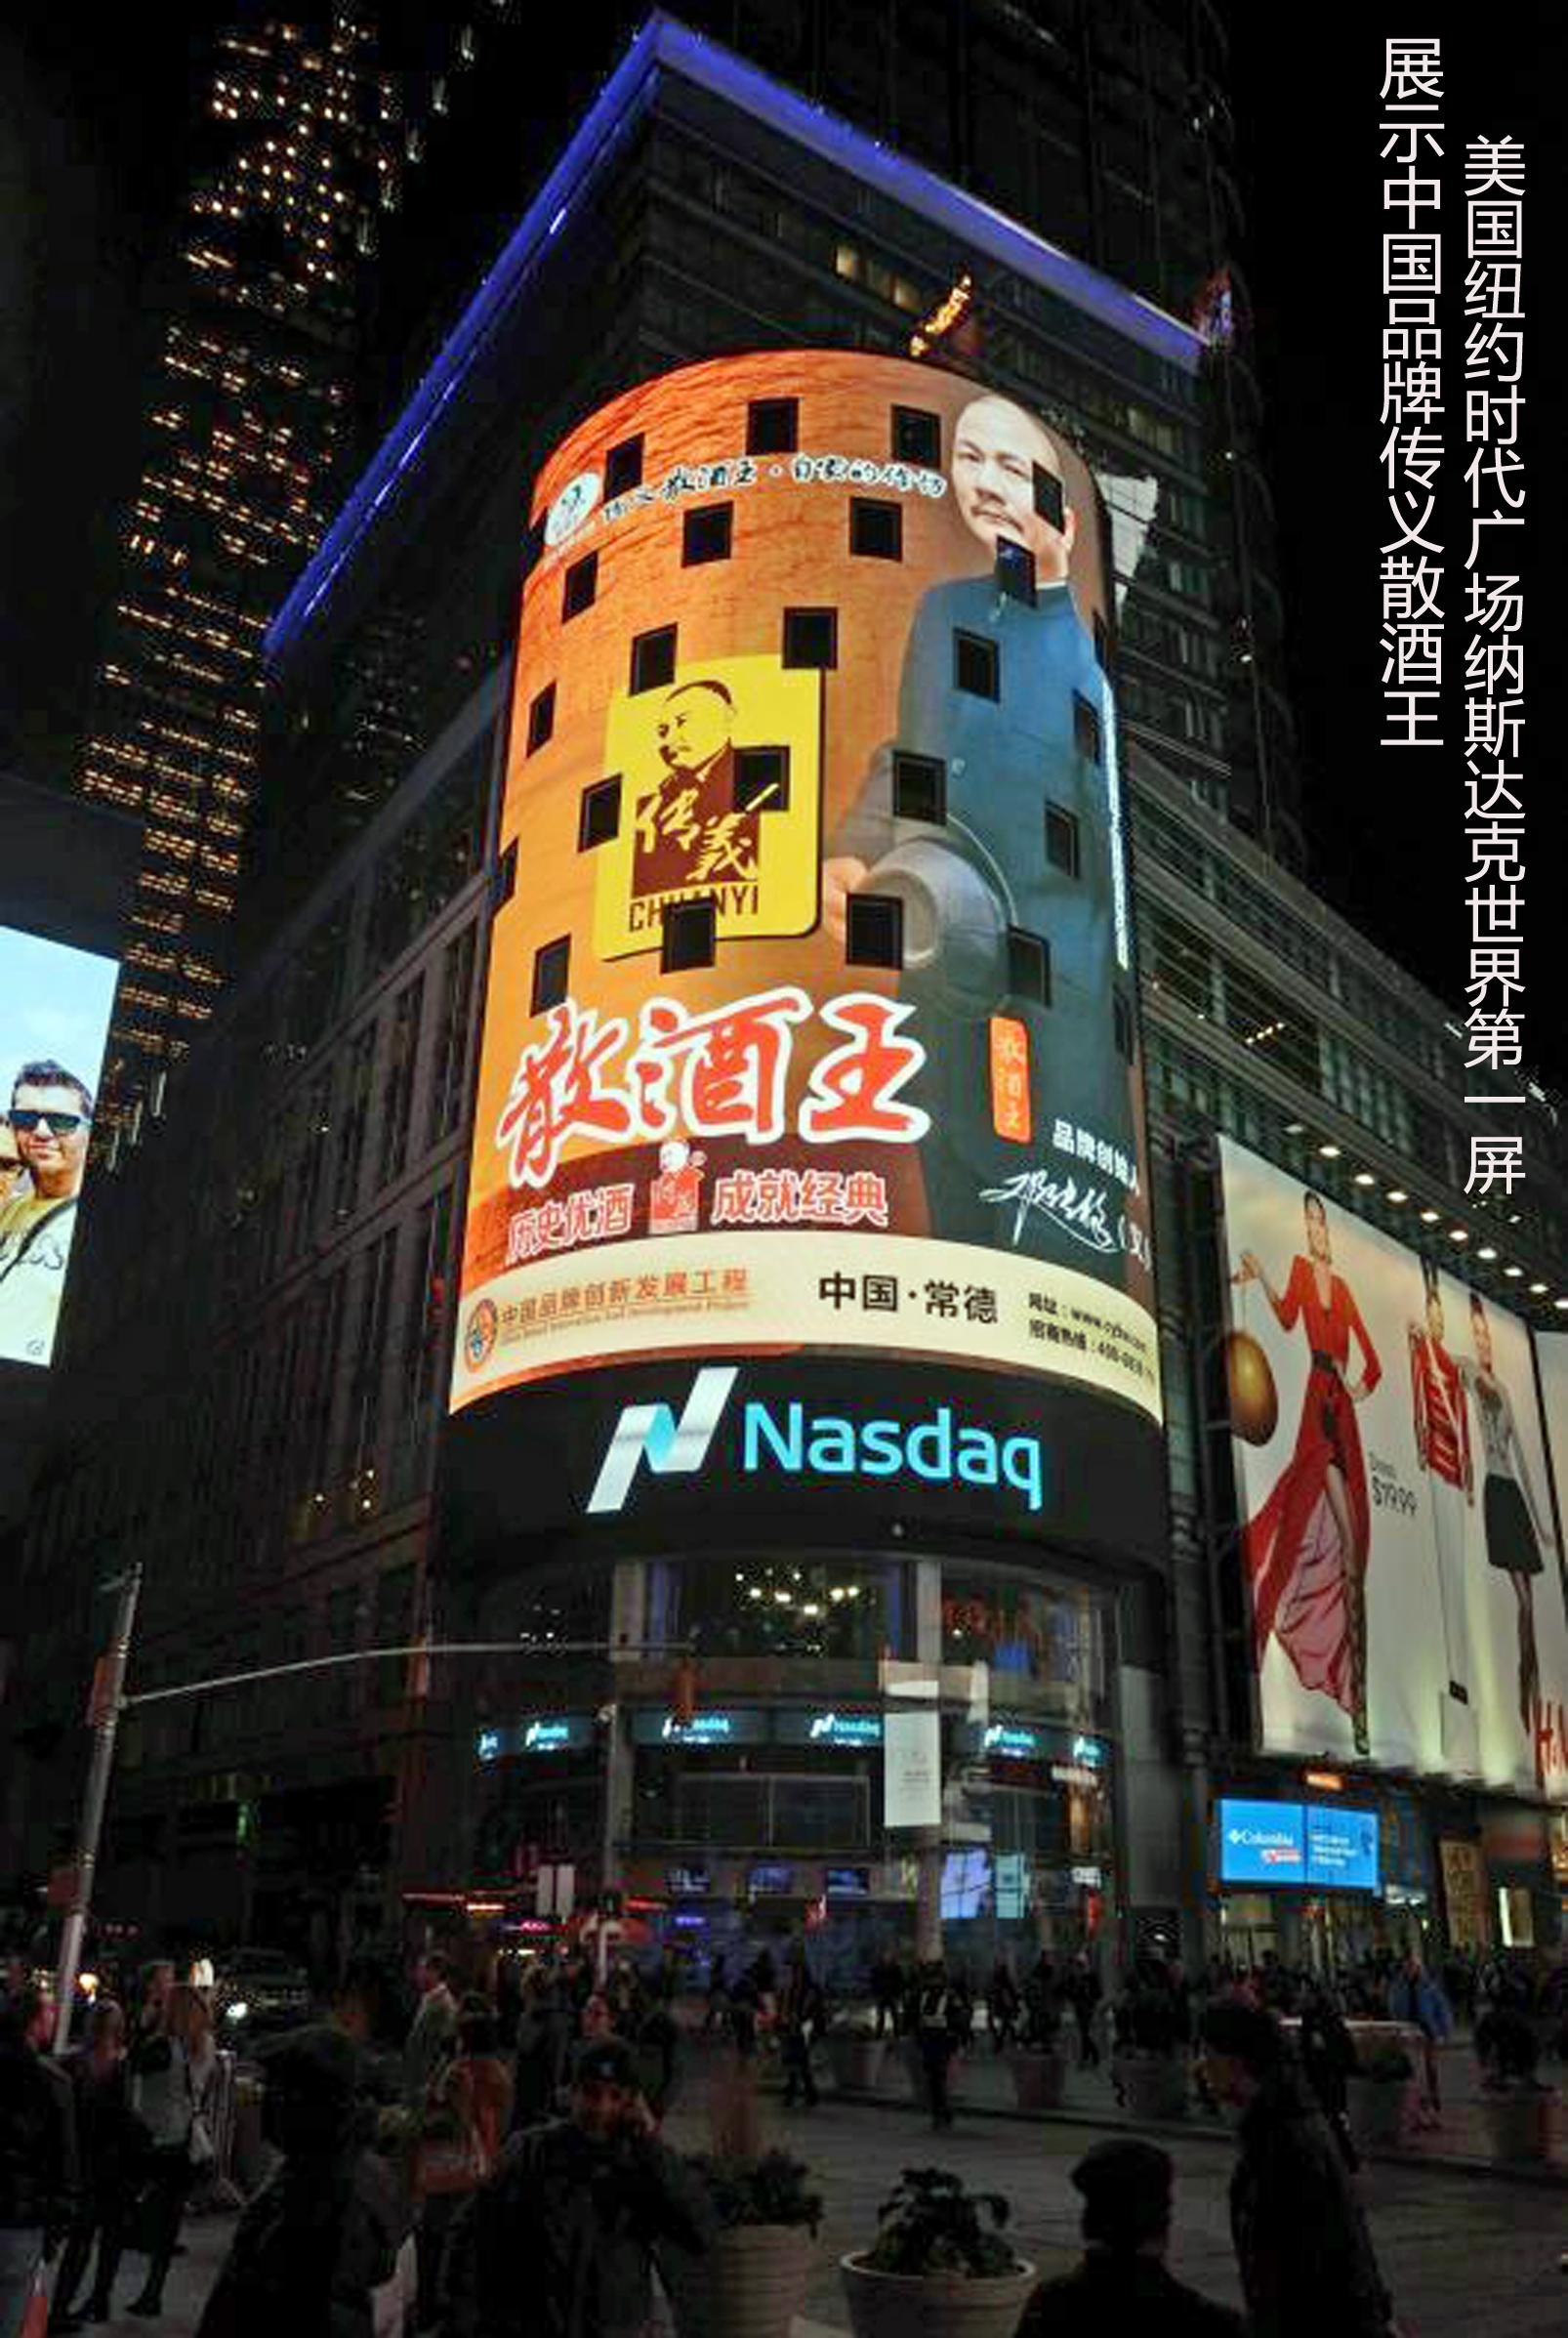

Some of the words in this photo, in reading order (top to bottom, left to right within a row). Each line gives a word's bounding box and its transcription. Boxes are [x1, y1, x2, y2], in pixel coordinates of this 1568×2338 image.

[629, 884, 759, 933] CHNYI
[496, 987, 932, 1189] 散酒王
[711, 1169, 888, 1227] 成就经典
[744, 1402, 1043, 1512] Nasdaq
[1371, 1476, 1418, 1517] $19.99
